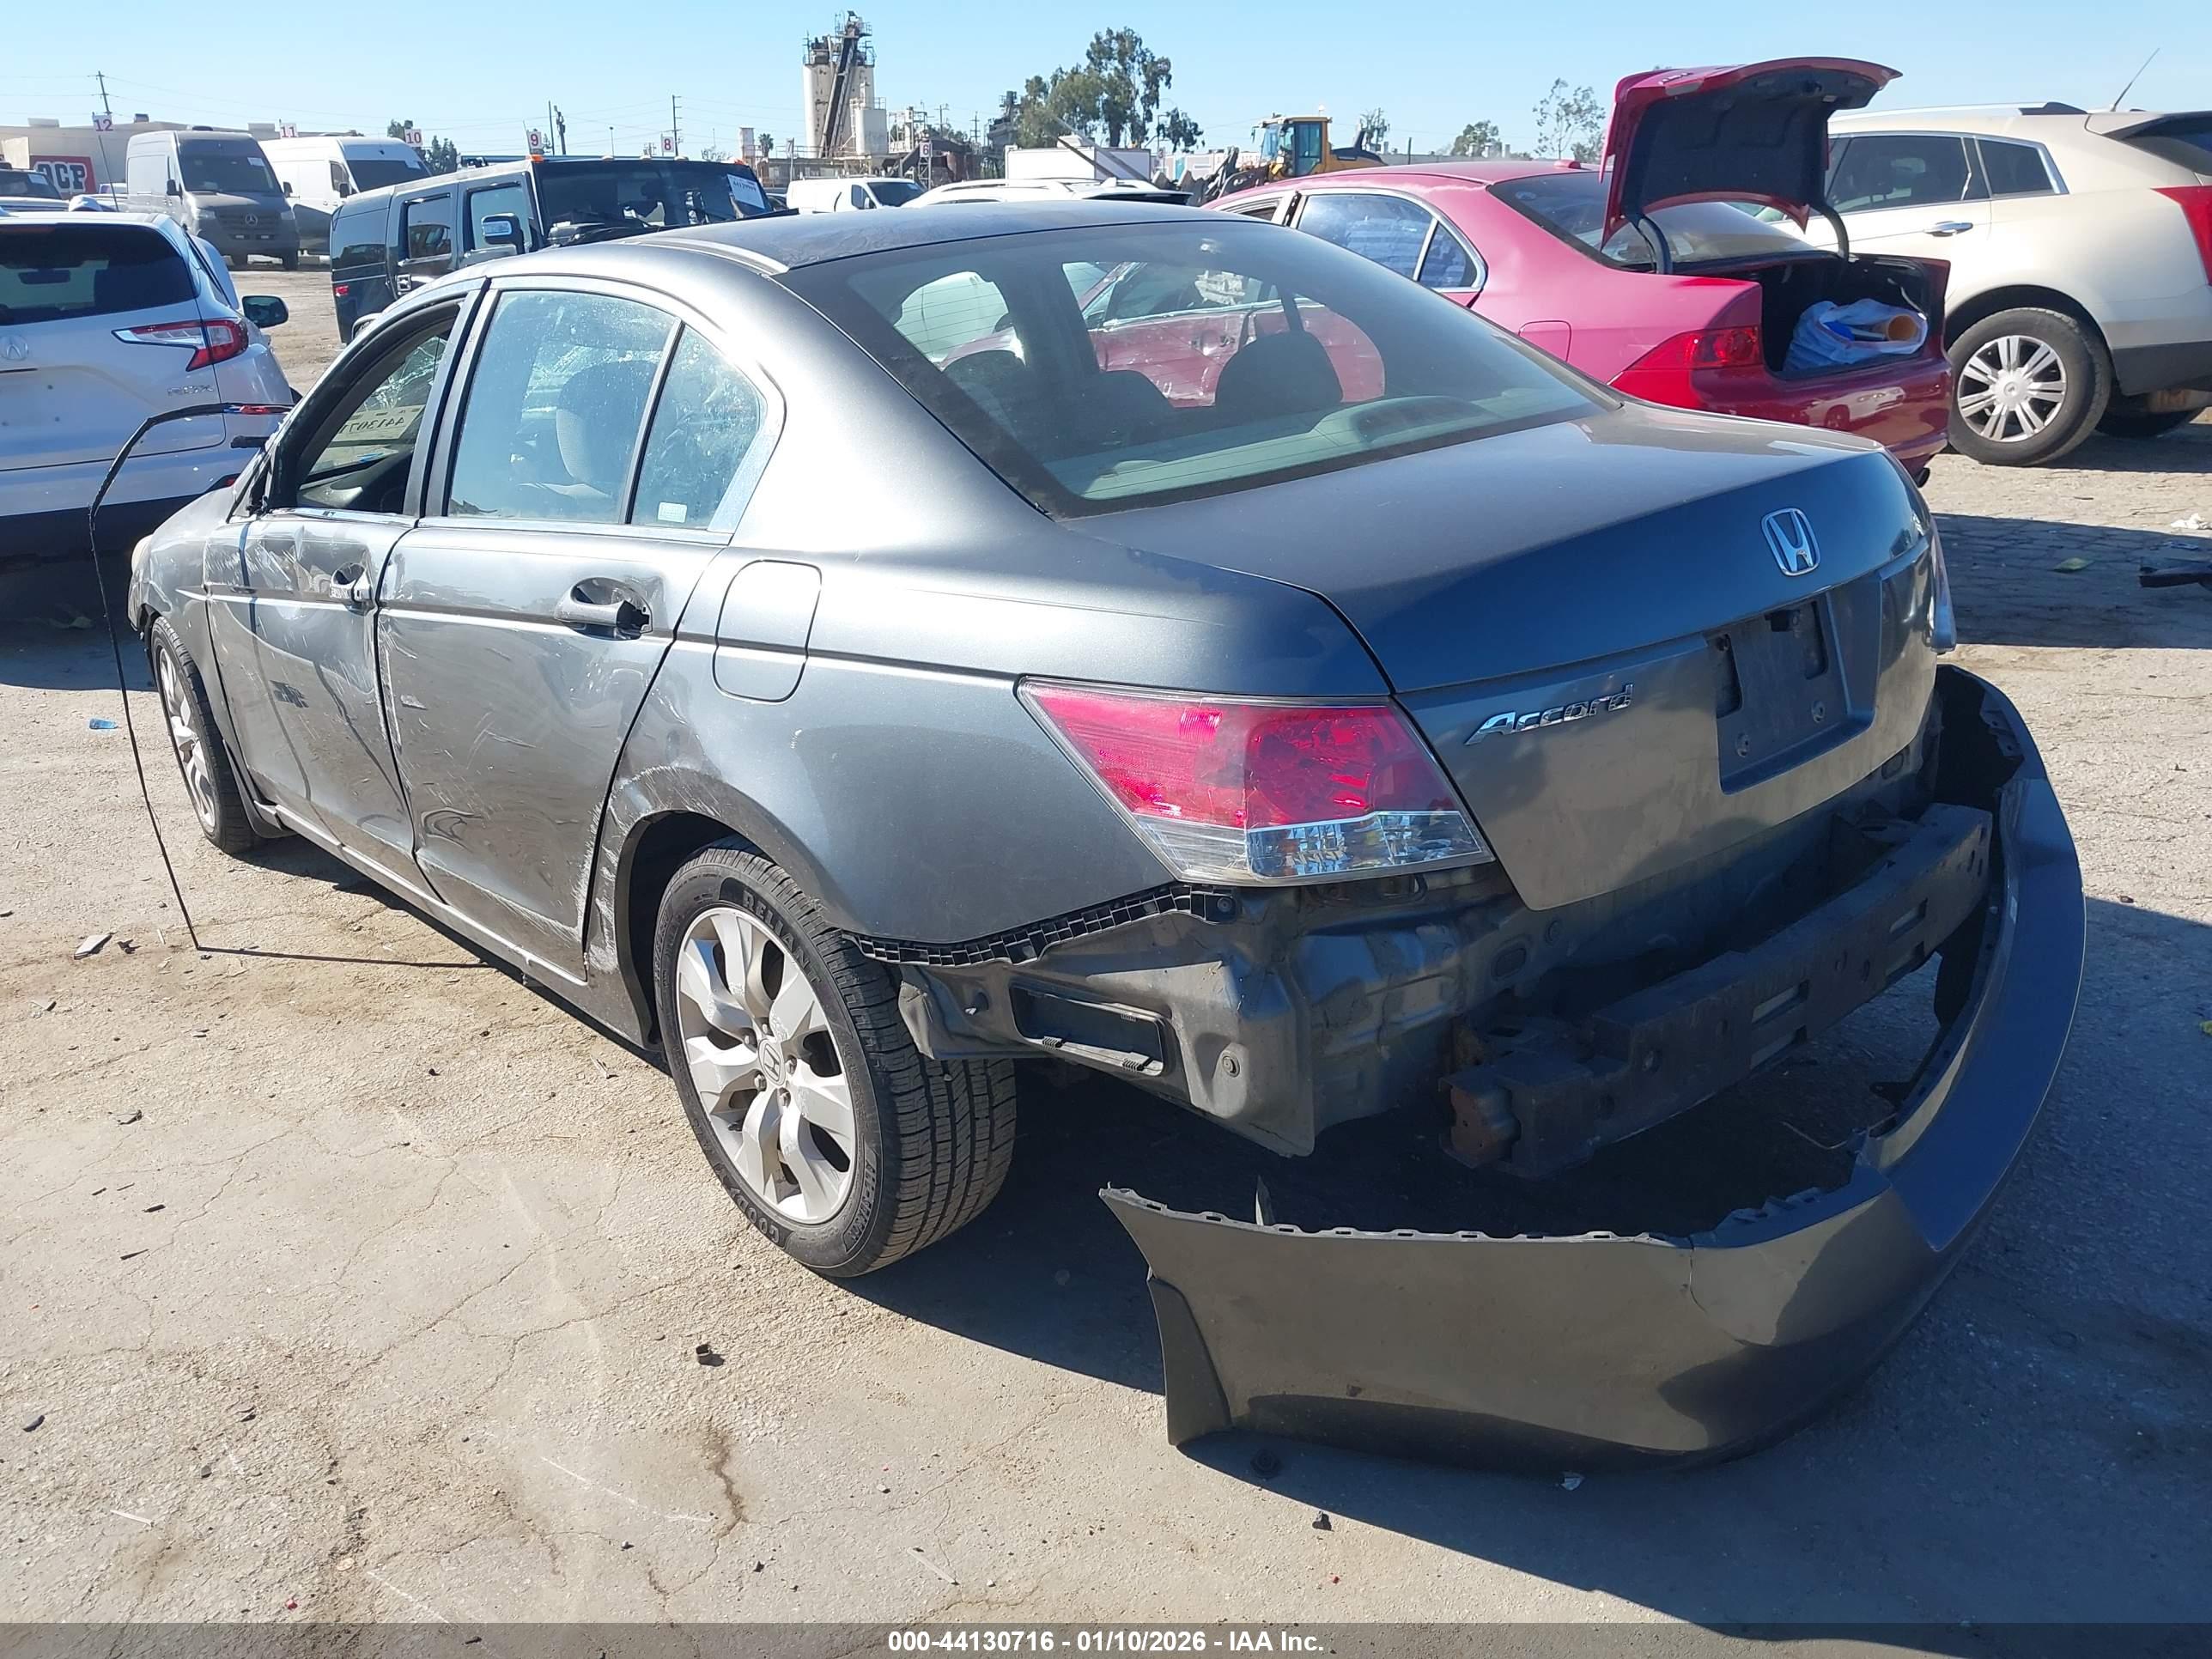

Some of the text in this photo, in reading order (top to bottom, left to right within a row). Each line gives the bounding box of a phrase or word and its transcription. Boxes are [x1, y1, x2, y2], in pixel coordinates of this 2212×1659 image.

[94, 118, 113, 132] 12
[280, 126, 298, 138] 11
[405, 131, 422, 144] 10
[530, 133, 539, 146] 9
[664, 138, 672, 150] 8
[922, 144, 929, 155] 6
[1464, 684, 1634, 745] Accord
[743, 890, 823, 985] RELIANT
